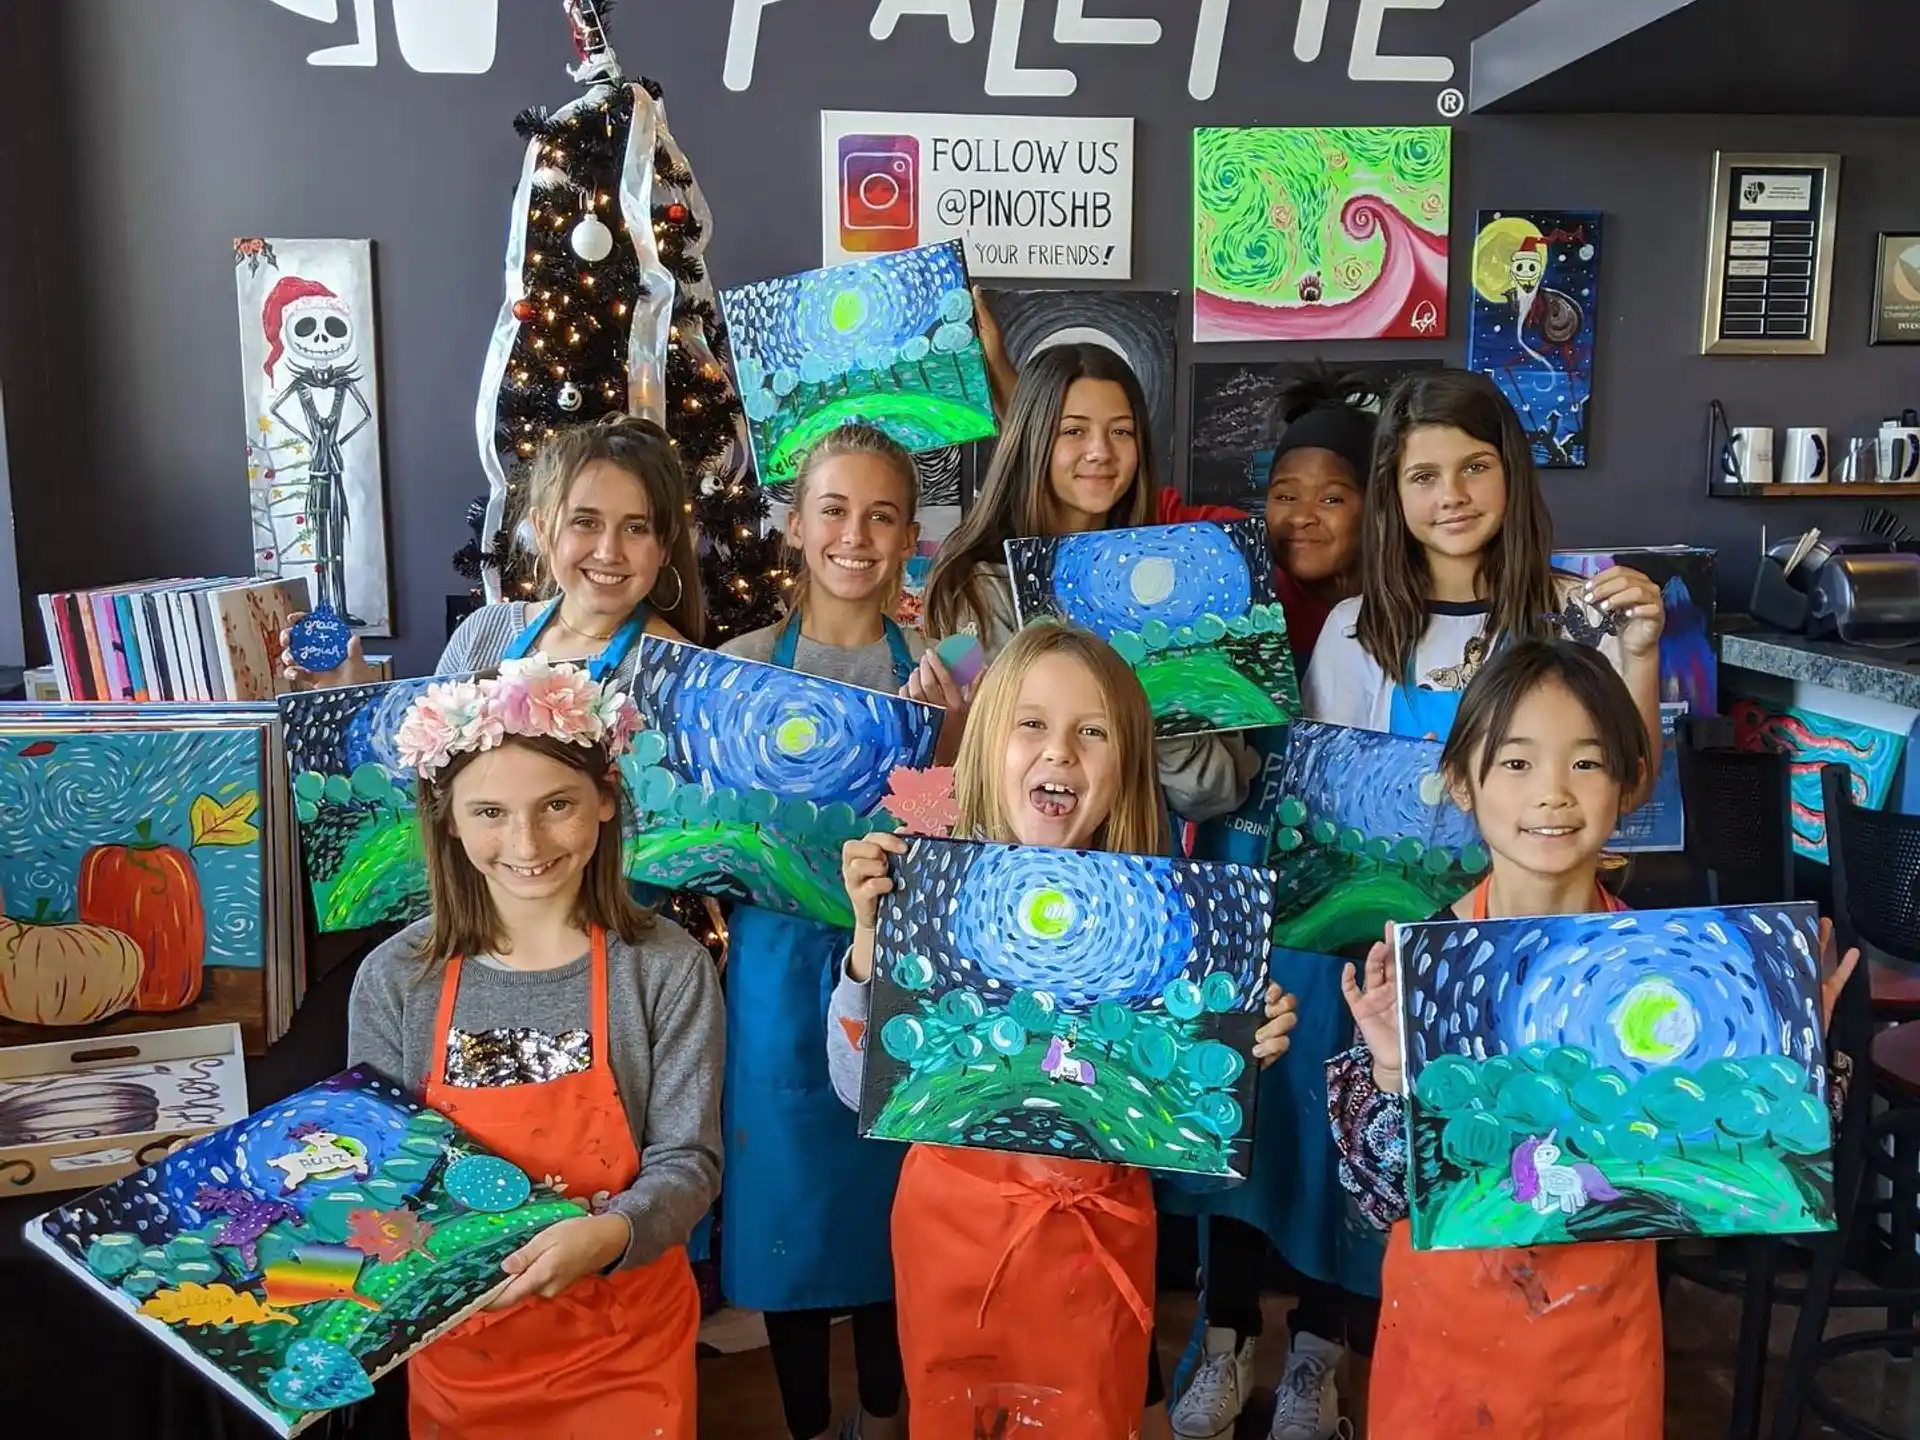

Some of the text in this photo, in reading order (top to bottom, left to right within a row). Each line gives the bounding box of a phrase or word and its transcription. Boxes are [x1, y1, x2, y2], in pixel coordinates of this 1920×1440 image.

[722, 0, 1455, 100] PLTE
[931, 137, 1120, 175] FOLLOW US
[937, 188, 1112, 229] @PINOTSHB
[974, 243, 1116, 267] YOUR FRIENDS!
[1234, 817, 1270, 837] DRIN
